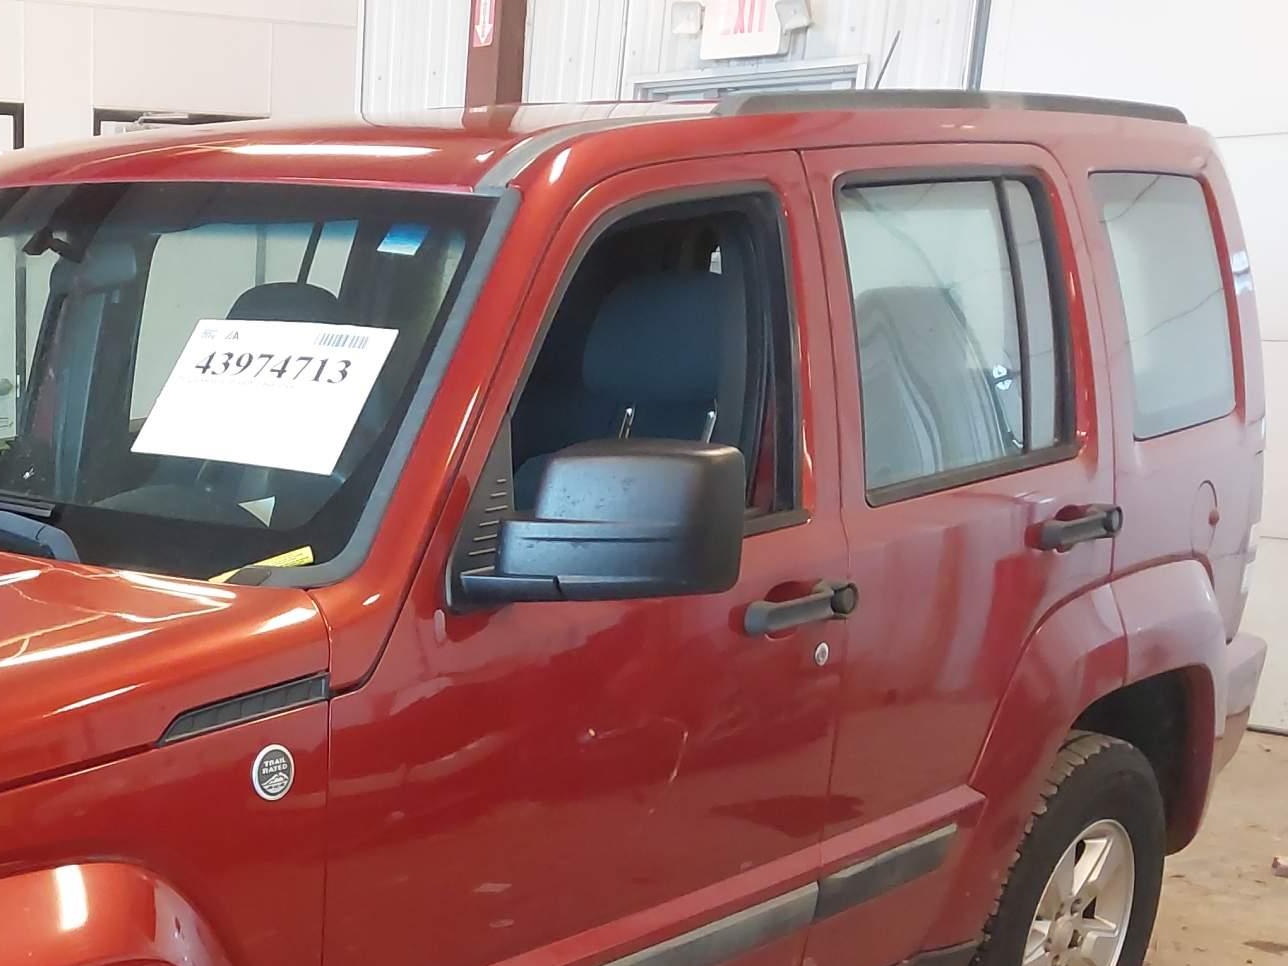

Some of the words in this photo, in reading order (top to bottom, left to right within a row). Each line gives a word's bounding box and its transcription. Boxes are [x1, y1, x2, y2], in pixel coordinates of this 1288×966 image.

[195, 351, 352, 384] 43974713
[263, 757, 286, 767] TRAIL
[261, 763, 288, 774] RATED
